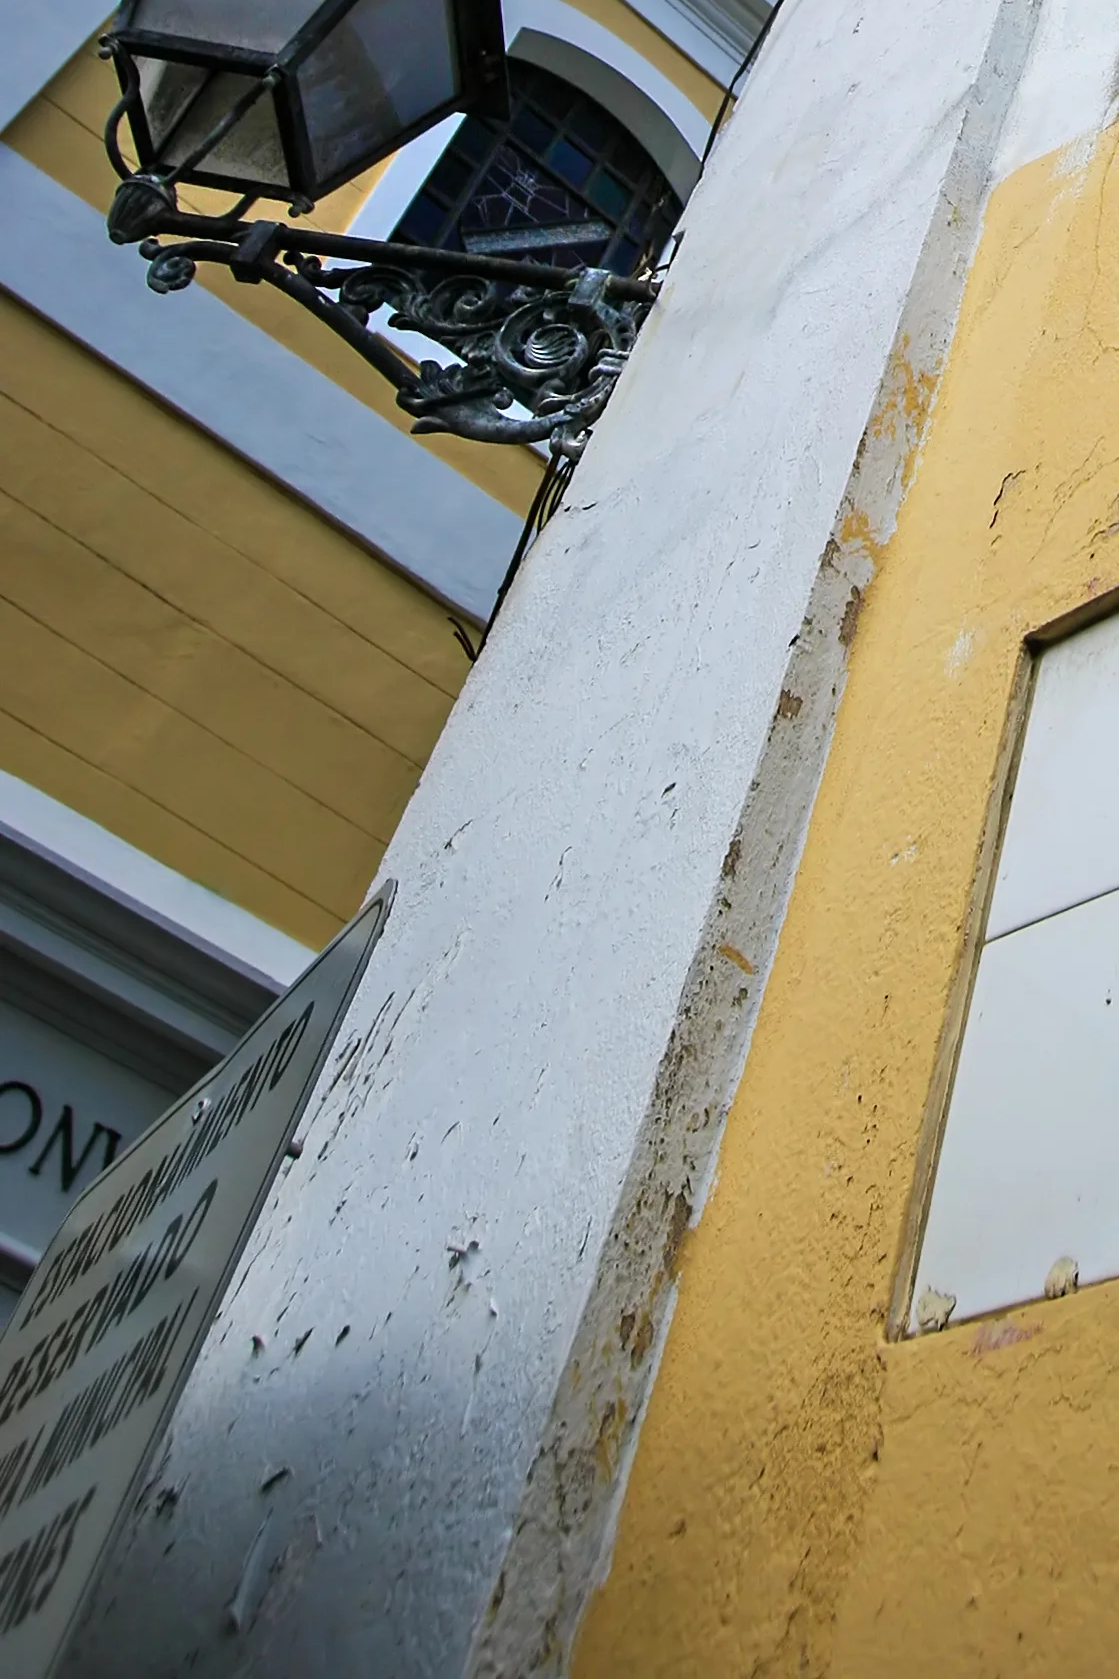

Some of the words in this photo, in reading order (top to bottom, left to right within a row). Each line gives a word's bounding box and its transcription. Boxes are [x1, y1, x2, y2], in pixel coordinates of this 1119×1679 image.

[0, 1080, 122, 1193] ON
[19, 1001, 315, 1331] ESTACIONAMIENTO
[17, 1284, 201, 1507] MUNICIPAL
